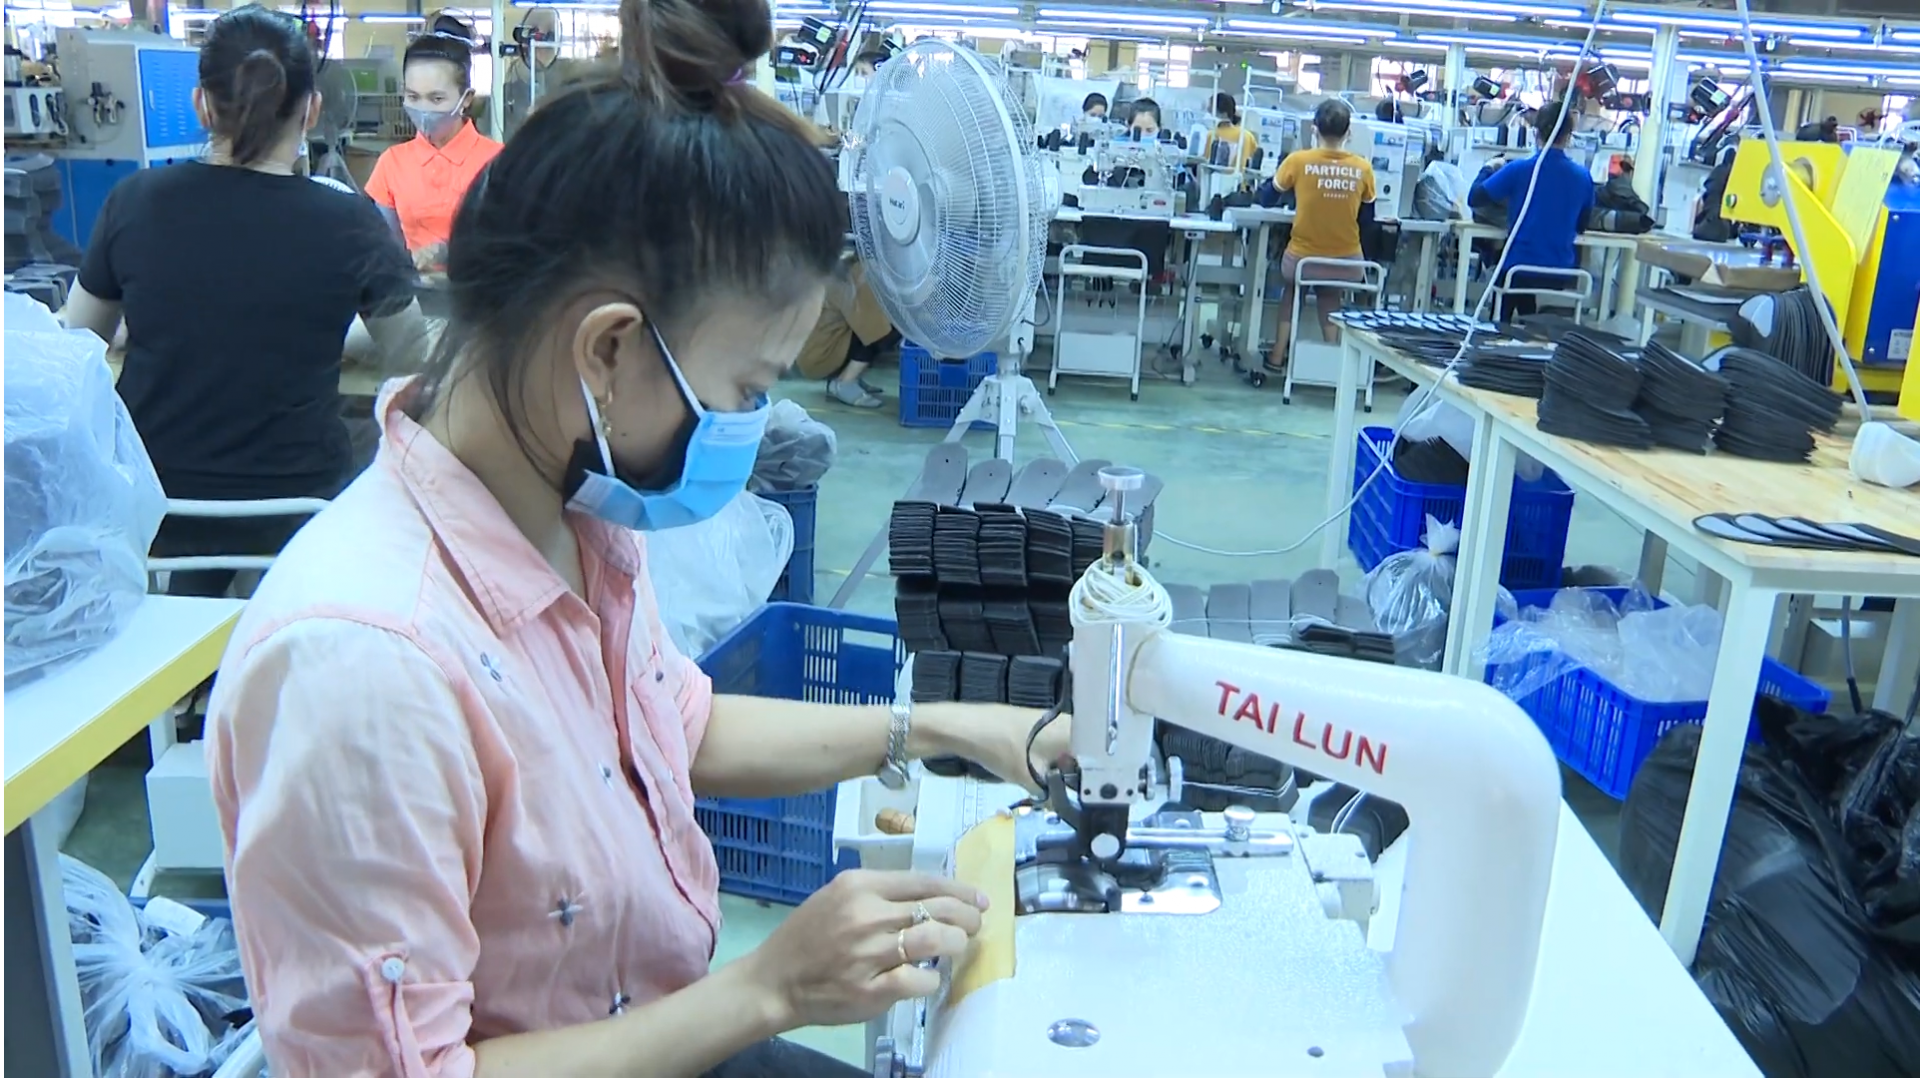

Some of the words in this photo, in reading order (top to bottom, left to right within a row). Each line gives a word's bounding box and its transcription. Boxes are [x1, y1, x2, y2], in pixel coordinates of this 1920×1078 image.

[1304, 164, 1362, 179] PARTICLE
[1317, 179, 1356, 191] FORCE
[1215, 680, 1279, 734] TAI
[1293, 711, 1387, 775] LUN
